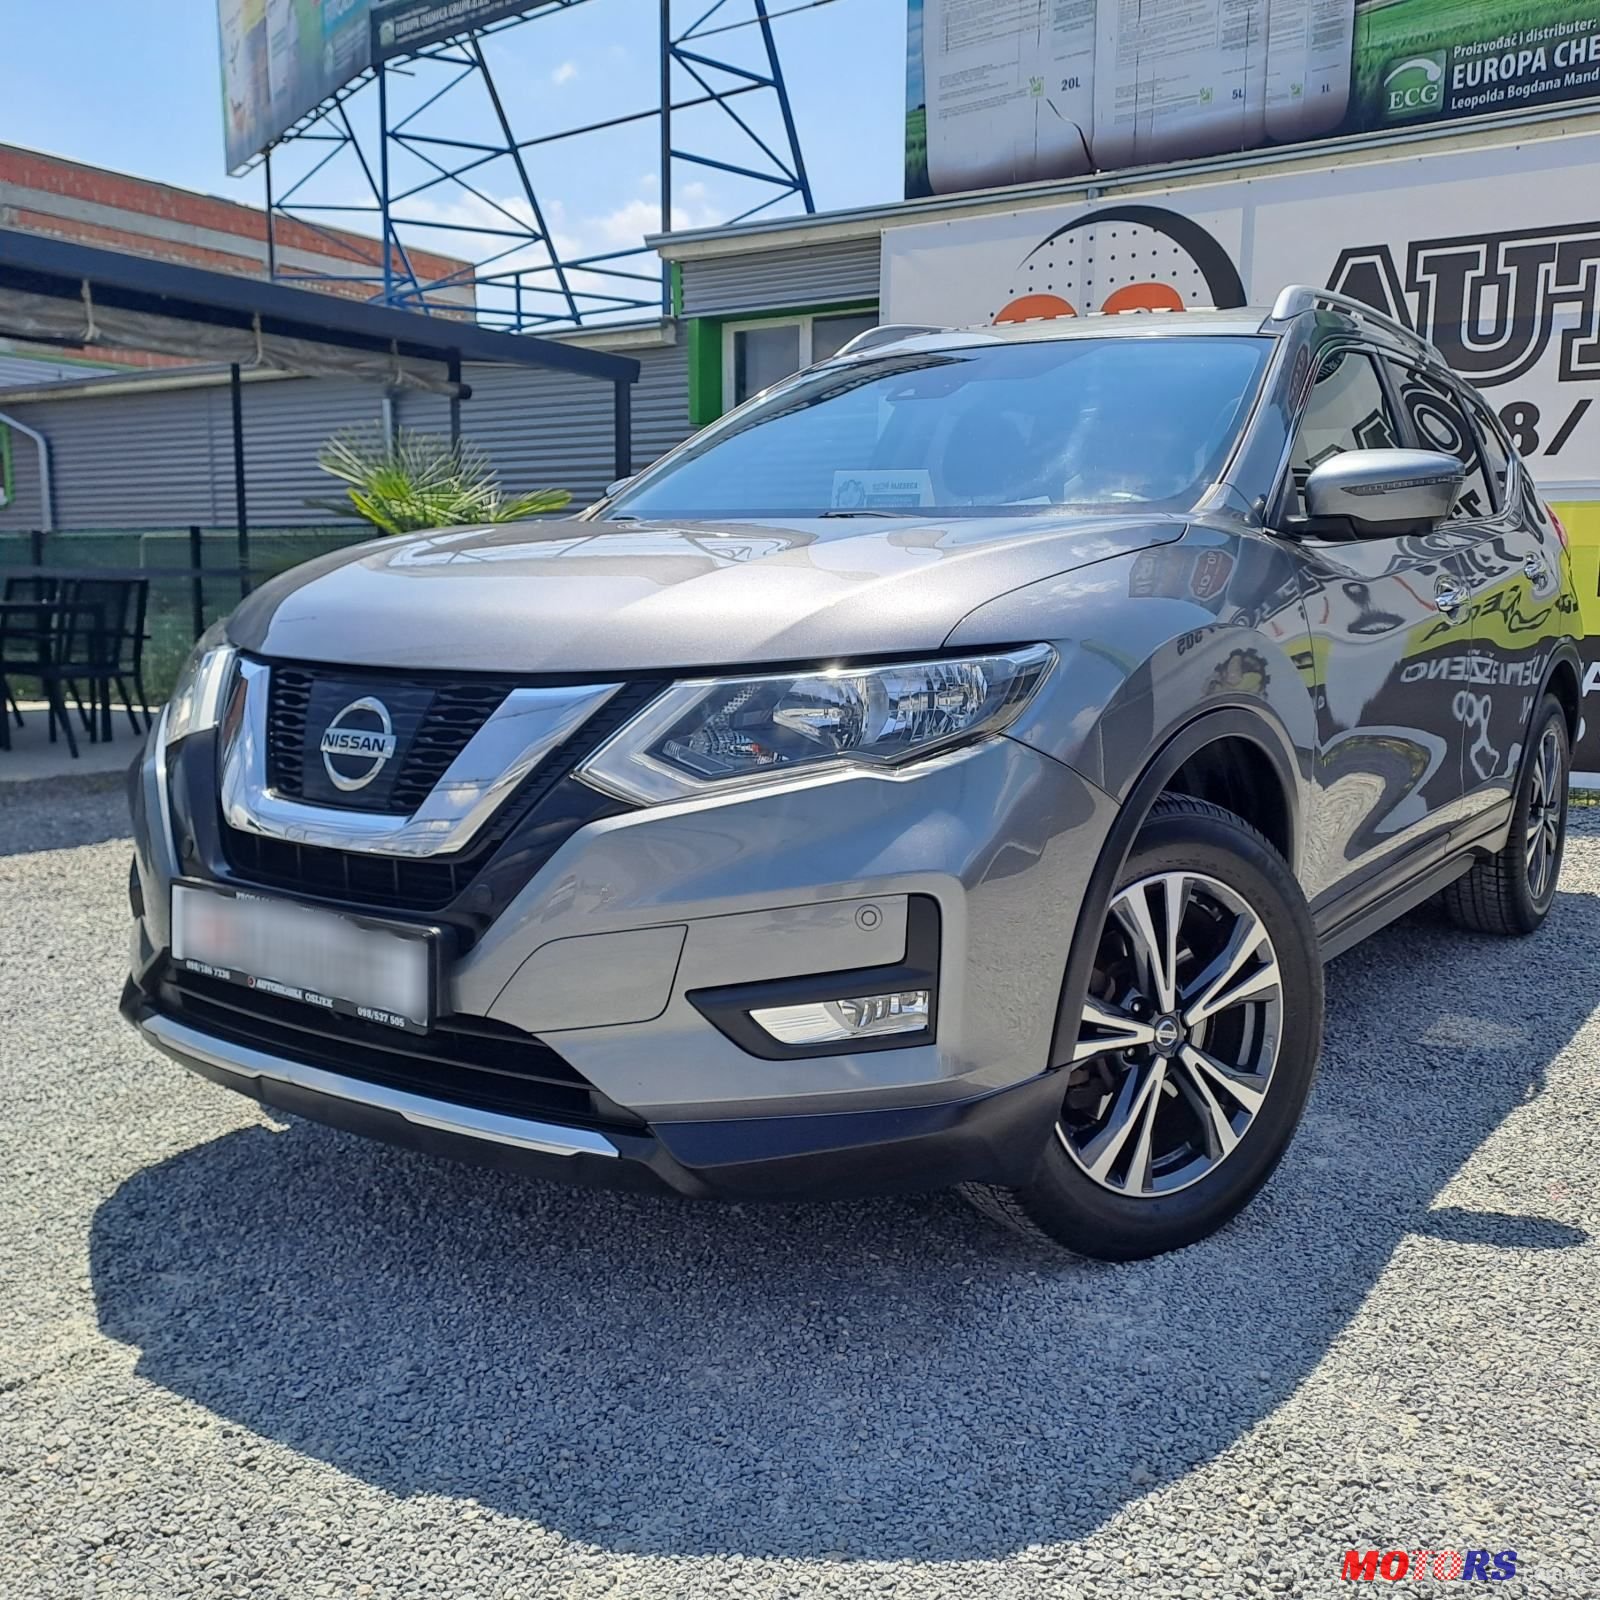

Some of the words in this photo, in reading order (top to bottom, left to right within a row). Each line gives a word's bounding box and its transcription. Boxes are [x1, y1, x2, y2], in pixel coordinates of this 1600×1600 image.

[1526, 18, 1597, 43] distributer:
[1452, 46, 1547, 90] EUROPA
[1061, 76, 1081, 91] 20L
[1231, 88, 1243, 100] 5L
[1451, 89, 1505, 111] Leopolda
[1507, 78, 1561, 99] Bogdana
[1388, 84, 1439, 111] ECG
[323, 733, 386, 752] NISSAN
[357, 1007, 389, 1024] 098/537
[389, 1014, 406, 1028] 505
